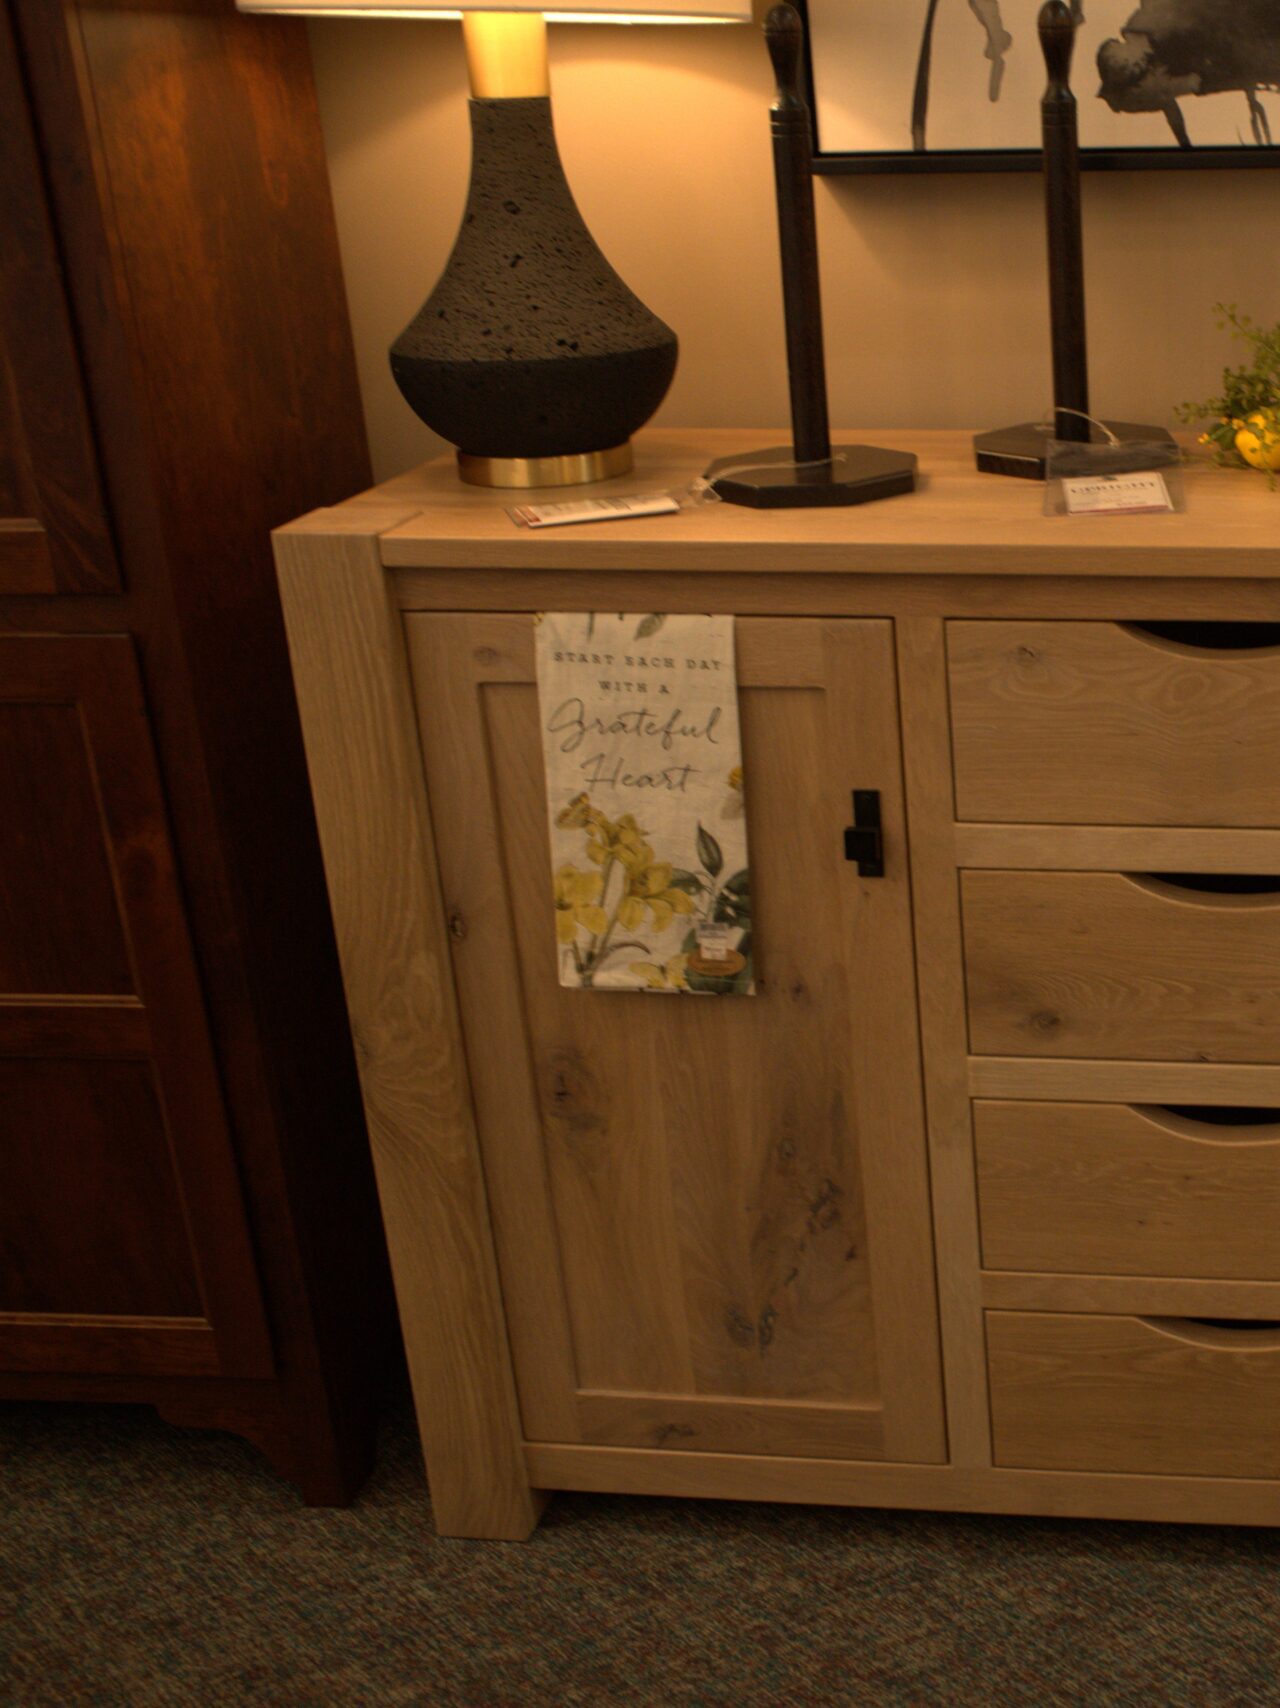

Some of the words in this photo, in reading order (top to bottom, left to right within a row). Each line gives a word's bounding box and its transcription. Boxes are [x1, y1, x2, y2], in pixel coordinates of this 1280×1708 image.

[553, 651, 615, 666] START
[624, 655, 676, 669] EACH
[685, 658, 722, 671] DAY
[598, 680, 648, 693] WITH
[658, 684, 670, 694] A
[547, 697, 722, 753] Grateful
[580, 752, 702, 793] Heart
